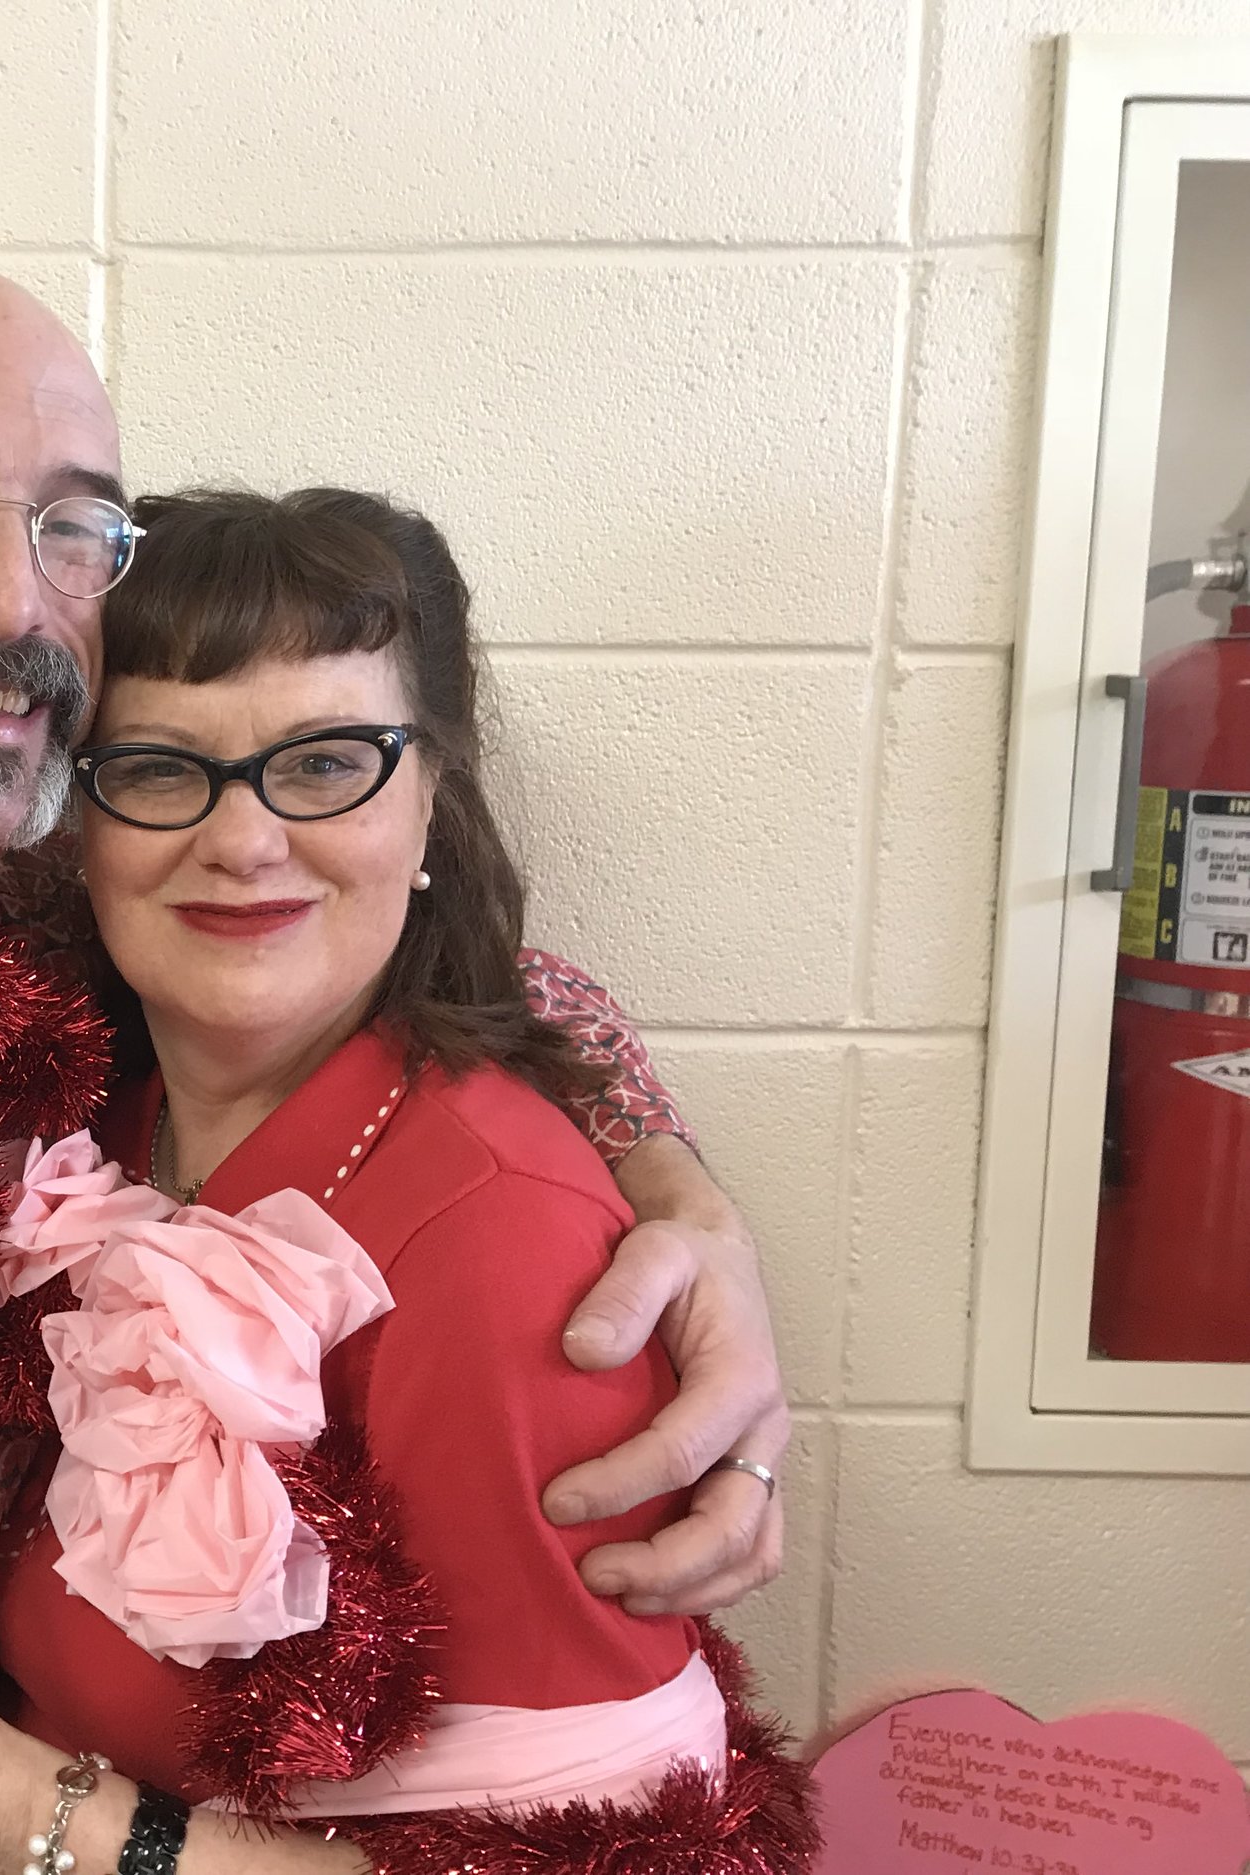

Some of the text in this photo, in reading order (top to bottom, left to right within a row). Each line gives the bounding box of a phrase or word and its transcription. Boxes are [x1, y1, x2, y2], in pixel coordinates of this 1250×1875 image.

[1169, 807, 1182, 832] A
[1165, 863, 1177, 888] B
[1160, 919, 1173, 944] C
[889, 1712, 1220, 1794] Everyone who acknowledges me
[965, 1755, 1008, 1776] here
[1018, 1769, 1039, 1782] on
[1111, 1778, 1127, 1799] I
[879, 1761, 1153, 1841] acknowledge before before my
[972, 1802, 989, 1818] in
[899, 1819, 983, 1862] Matthew
